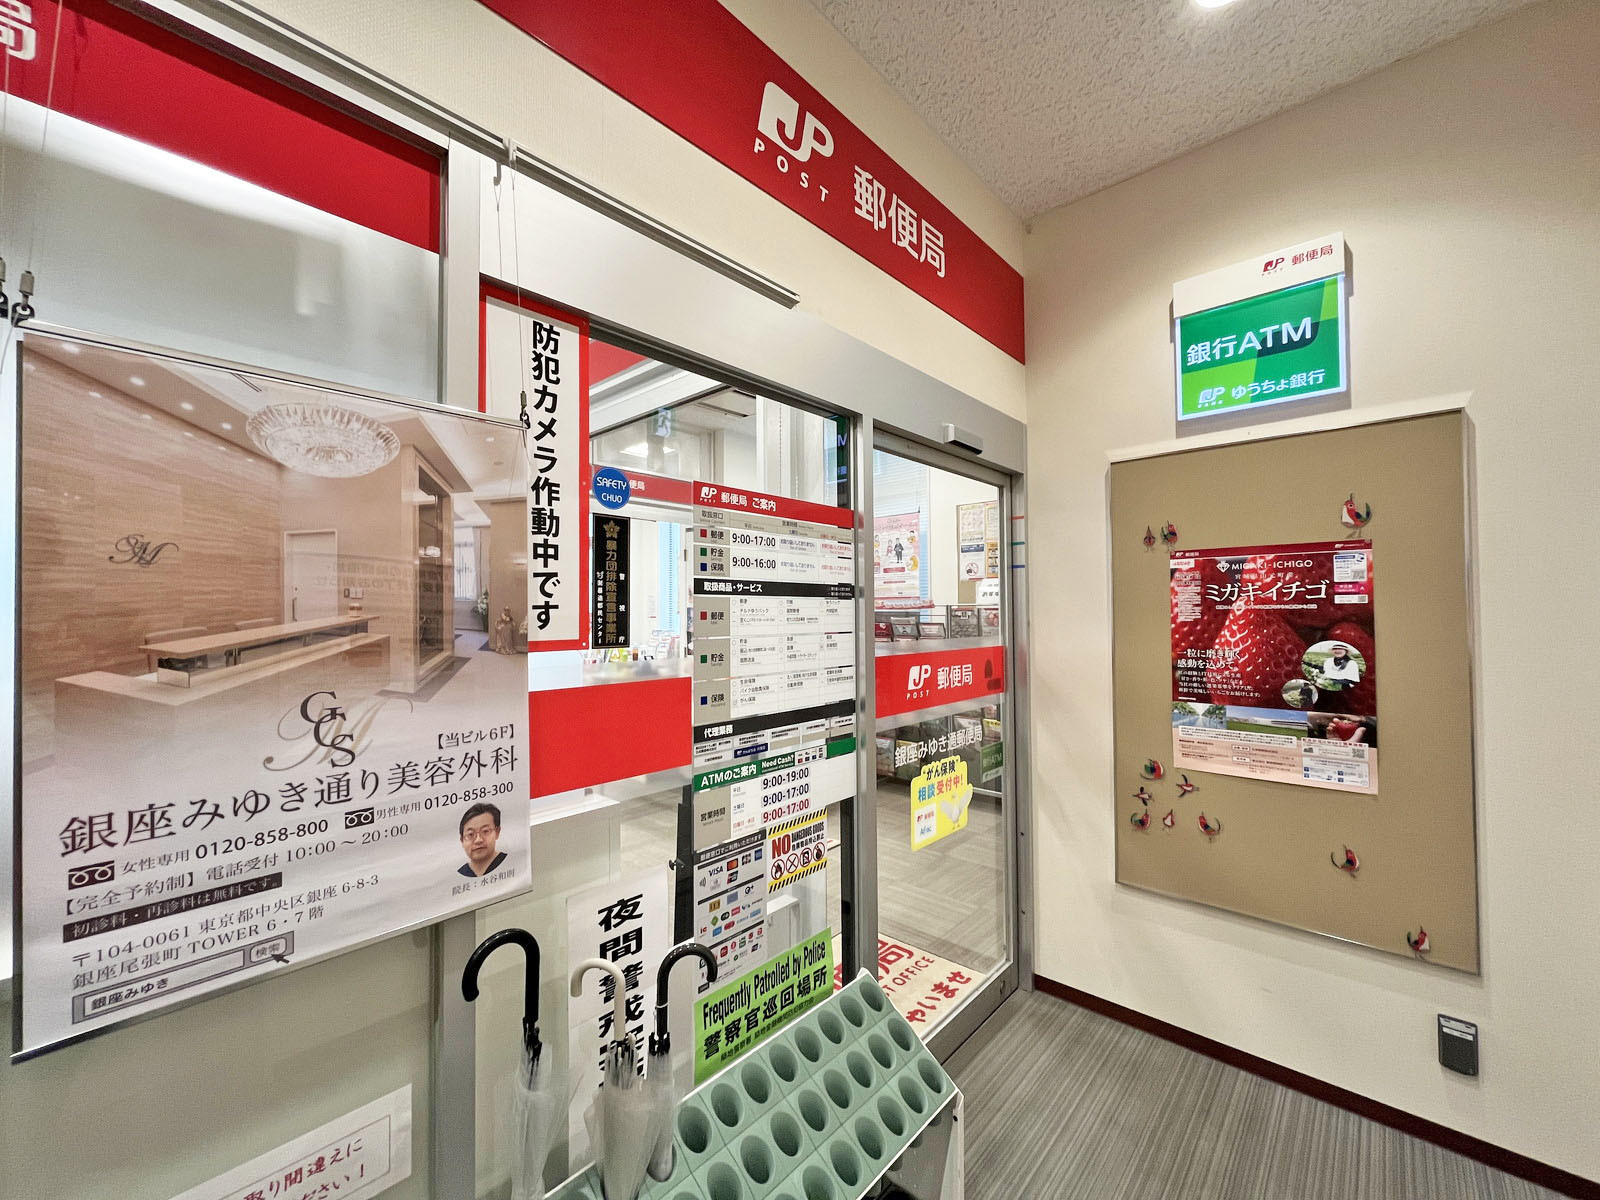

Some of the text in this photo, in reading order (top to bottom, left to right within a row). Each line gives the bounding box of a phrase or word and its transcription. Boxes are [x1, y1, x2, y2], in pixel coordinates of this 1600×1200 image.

[753, 137, 829, 203] POST
[854, 164, 946, 278] 郵便局
[1291, 244, 1333, 266] 郵便局
[1186, 316, 1312, 367] 銀行ATM
[1231, 369, 1325, 400] ゆうちょ銀行
[531, 320, 561, 630] 防犯カメラ作動中です
[596, 476, 627, 490] SAFETY
[601, 493, 623, 503] CHUO
[720, 491, 777, 512] 郵便局 ご案内
[710, 530, 724, 541] 郵便
[732, 532, 776, 547] 9:00-17:00
[710, 548, 724, 558] 貯金
[732, 556, 776, 570] 9:00-16:00
[1231, 559, 1313, 571] MIGAKI-ICHIGO
[710, 563, 724, 573] 保険
[703, 581, 763, 593] 取扱商品・サービス
[1205, 580, 1330, 601] ミガキイチゴ
[710, 611, 725, 621] 郵便
[710, 653, 725, 663] 貯金
[936, 664, 973, 690] 郵便局
[710, 693, 725, 703] 保険
[906, 690, 930, 700] POST
[437, 723, 515, 750] 【当ビル6F】
[703, 724, 734, 738] 代理業務
[894, 724, 983, 768] 銀座みゆき通郵便局
[761, 758, 777, 769] Need
[777, 754, 795, 765] Cash?
[700, 763, 757, 788] ATMのご案内
[762, 767, 809, 790] 9:00-19:00
[59, 745, 518, 857] 銀座みゆき通り美容外科
[376, 781, 514, 820] 男性専用 0120-858-300
[762, 783, 809, 807] 9:00-17:00
[700, 807, 726, 821] 営業時間
[762, 798, 809, 823] 9:00-17:00
[121, 819, 328, 875] 女性専用 0120-858-800
[771, 834, 791, 859] NO
[708, 865, 724, 877] VISA
[66, 867, 195, 916] 【完全予約制】
[206, 851, 279, 881] 電話受付
[200, 885, 337, 932] 東京都中央区銀座
[342, 874, 379, 893] 6-8-3
[72, 945, 180, 990] 銀座尾張町
[187, 925, 260, 950] TOWER
[892, 956, 935, 986] OFFICE
[91, 978, 169, 1010] 銀座みゆき
[703, 972, 752, 1031] Frequently
[753, 955, 790, 998] Patrolled
[791, 952, 802, 979] by
[803, 941, 826, 972] Police
[704, 965, 827, 1060] 警察官巡回場所
